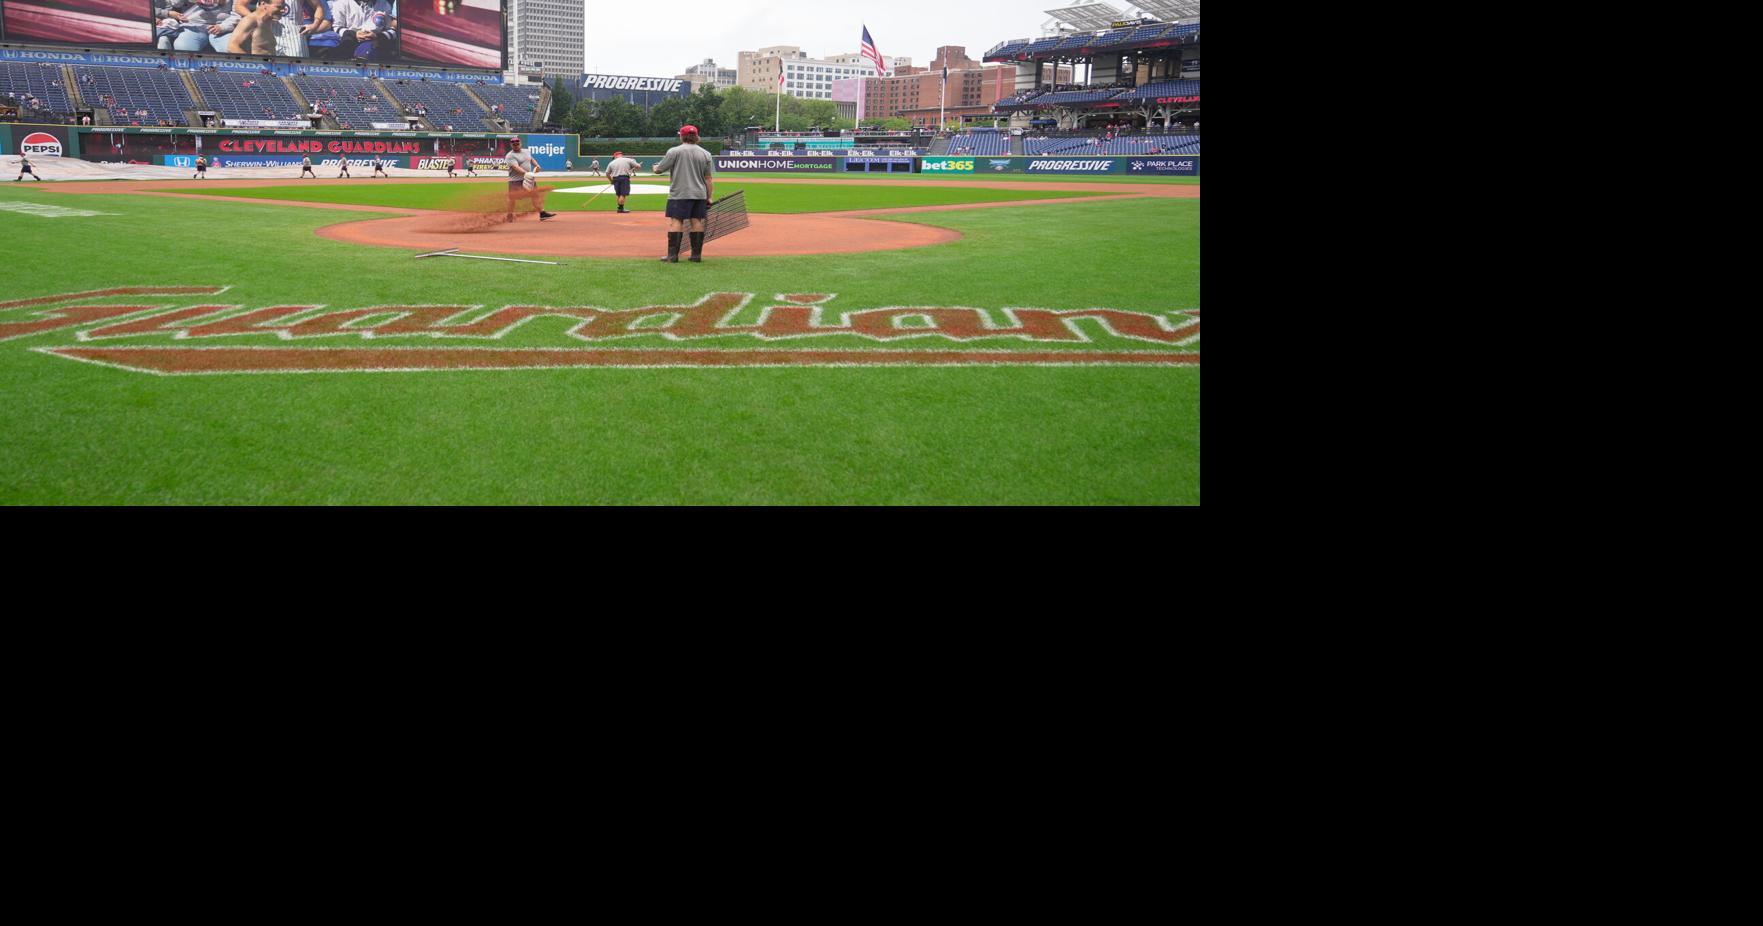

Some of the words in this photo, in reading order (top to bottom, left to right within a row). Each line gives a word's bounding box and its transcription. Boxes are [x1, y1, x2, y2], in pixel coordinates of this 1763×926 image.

[20, 51, 86, 61] HONDA
[106, 56, 167, 65] HONDA
[213, 61, 267, 70] HONDA
[310, 66, 359, 74] HONDA
[397, 70, 442, 79] HONDA
[456, 73, 498, 81] HONDA
[583, 75, 683, 92] PROGRESSIVE
[24, 145, 60, 153] PEPSI
[219, 139, 323, 153] CLEVELAND
[328, 140, 420, 154] GUARDIANS
[528, 145, 565, 156] meijer
[417, 158, 455, 170] BLASTE
[921, 160, 974, 170] bet365
[1029, 160, 1112, 170] PROGRESSIVE
[0, 285, 1200, 346] Guardian
